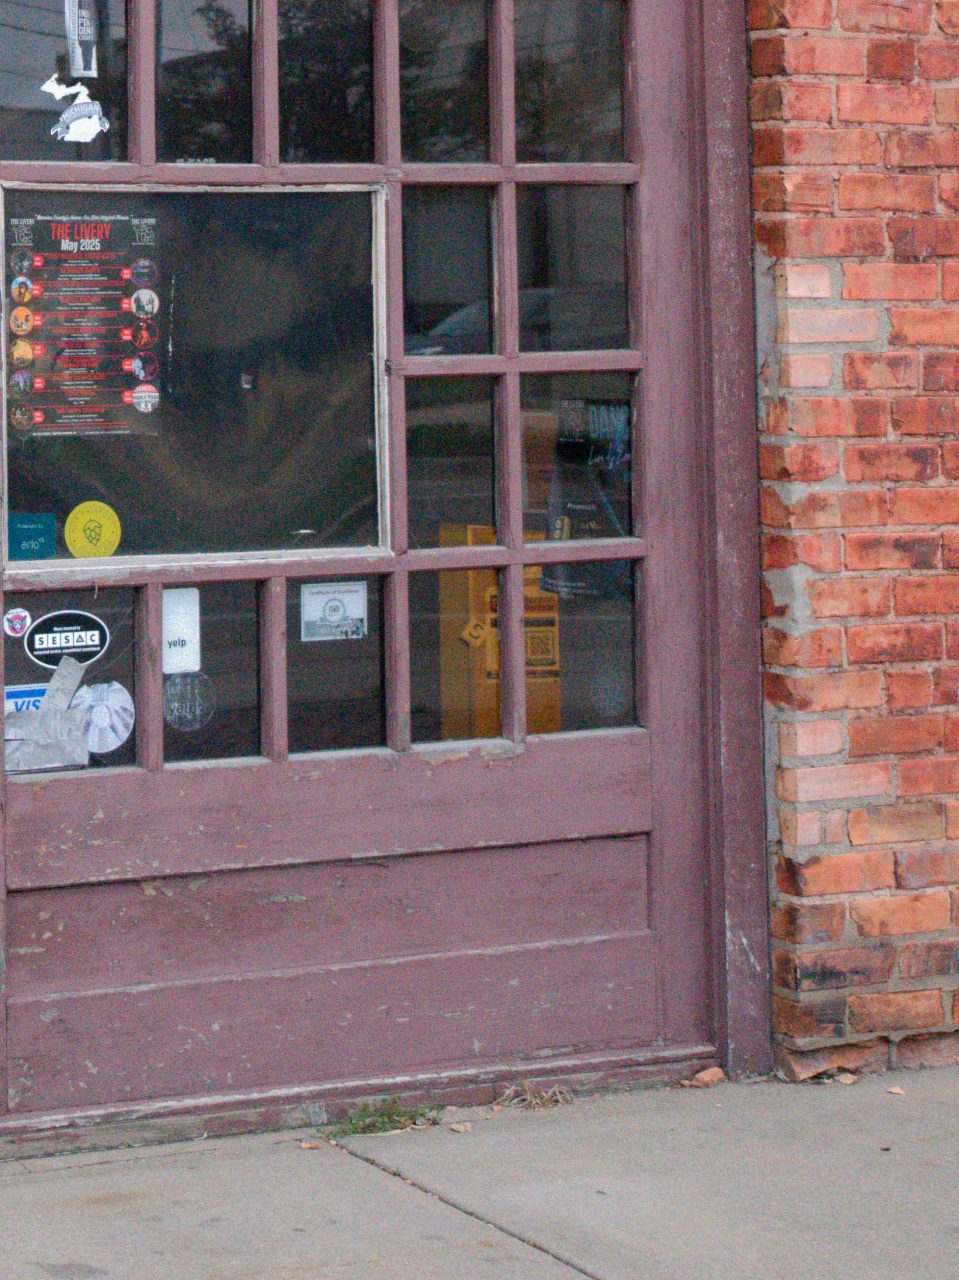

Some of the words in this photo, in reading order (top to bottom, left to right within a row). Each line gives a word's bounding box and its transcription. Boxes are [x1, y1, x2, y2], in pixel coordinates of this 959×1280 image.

[61, 103, 100, 121] MICHIGAN
[50, 223, 71, 240] THE
[73, 222, 112, 240] LIVERY
[61, 239, 78, 253] May
[79, 238, 101, 251] 2025
[167, 638, 187, 648] yelp
